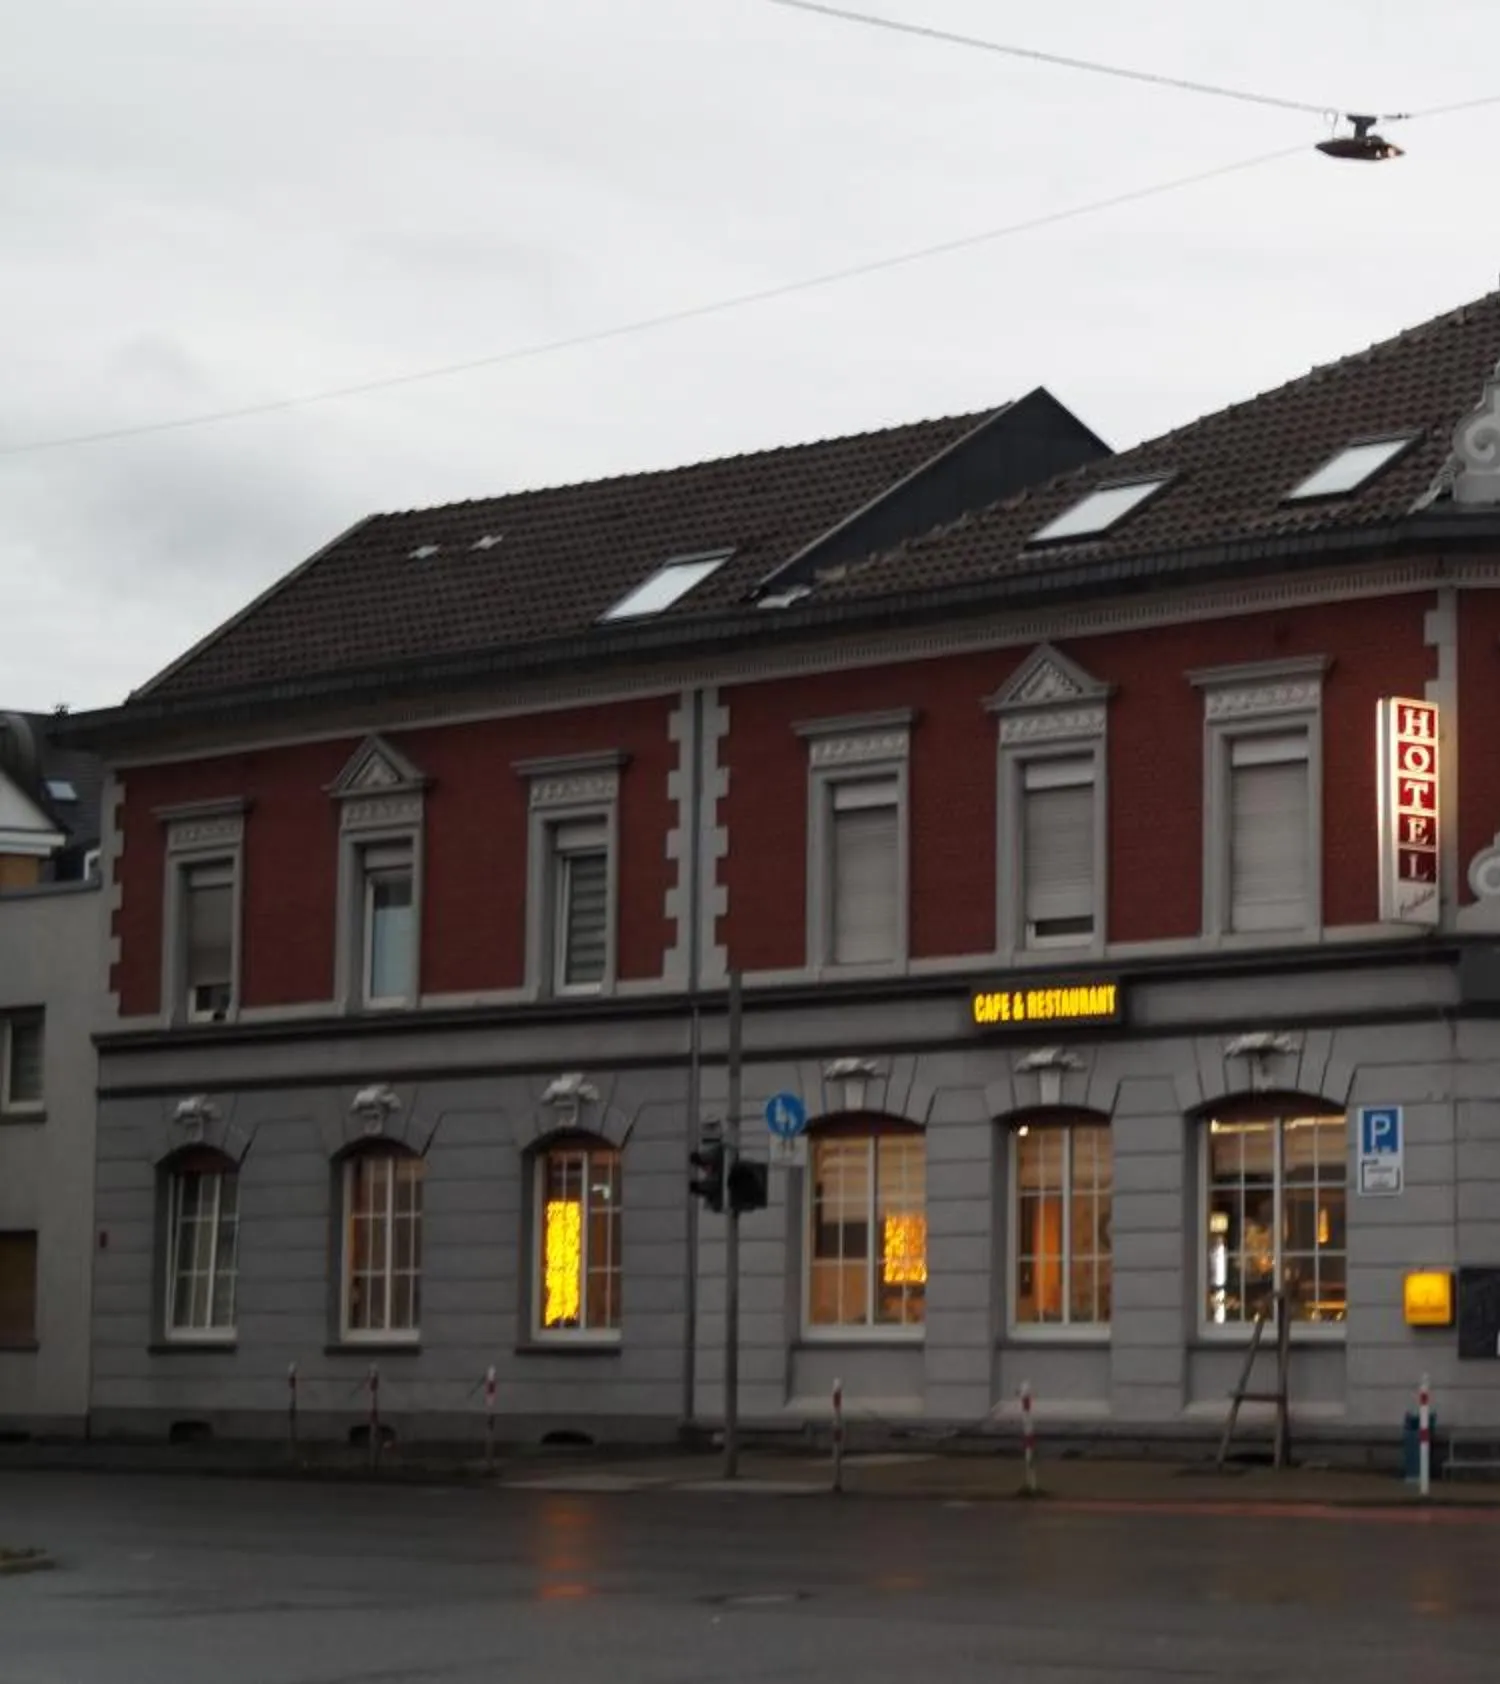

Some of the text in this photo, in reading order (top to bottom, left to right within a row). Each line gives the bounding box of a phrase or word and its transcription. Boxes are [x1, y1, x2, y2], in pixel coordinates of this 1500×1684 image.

[1403, 706, 1431, 879] HOTEL
[975, 985, 1116, 1023] CAFE & RESTAURANT
[1371, 1114, 1391, 1147] P
